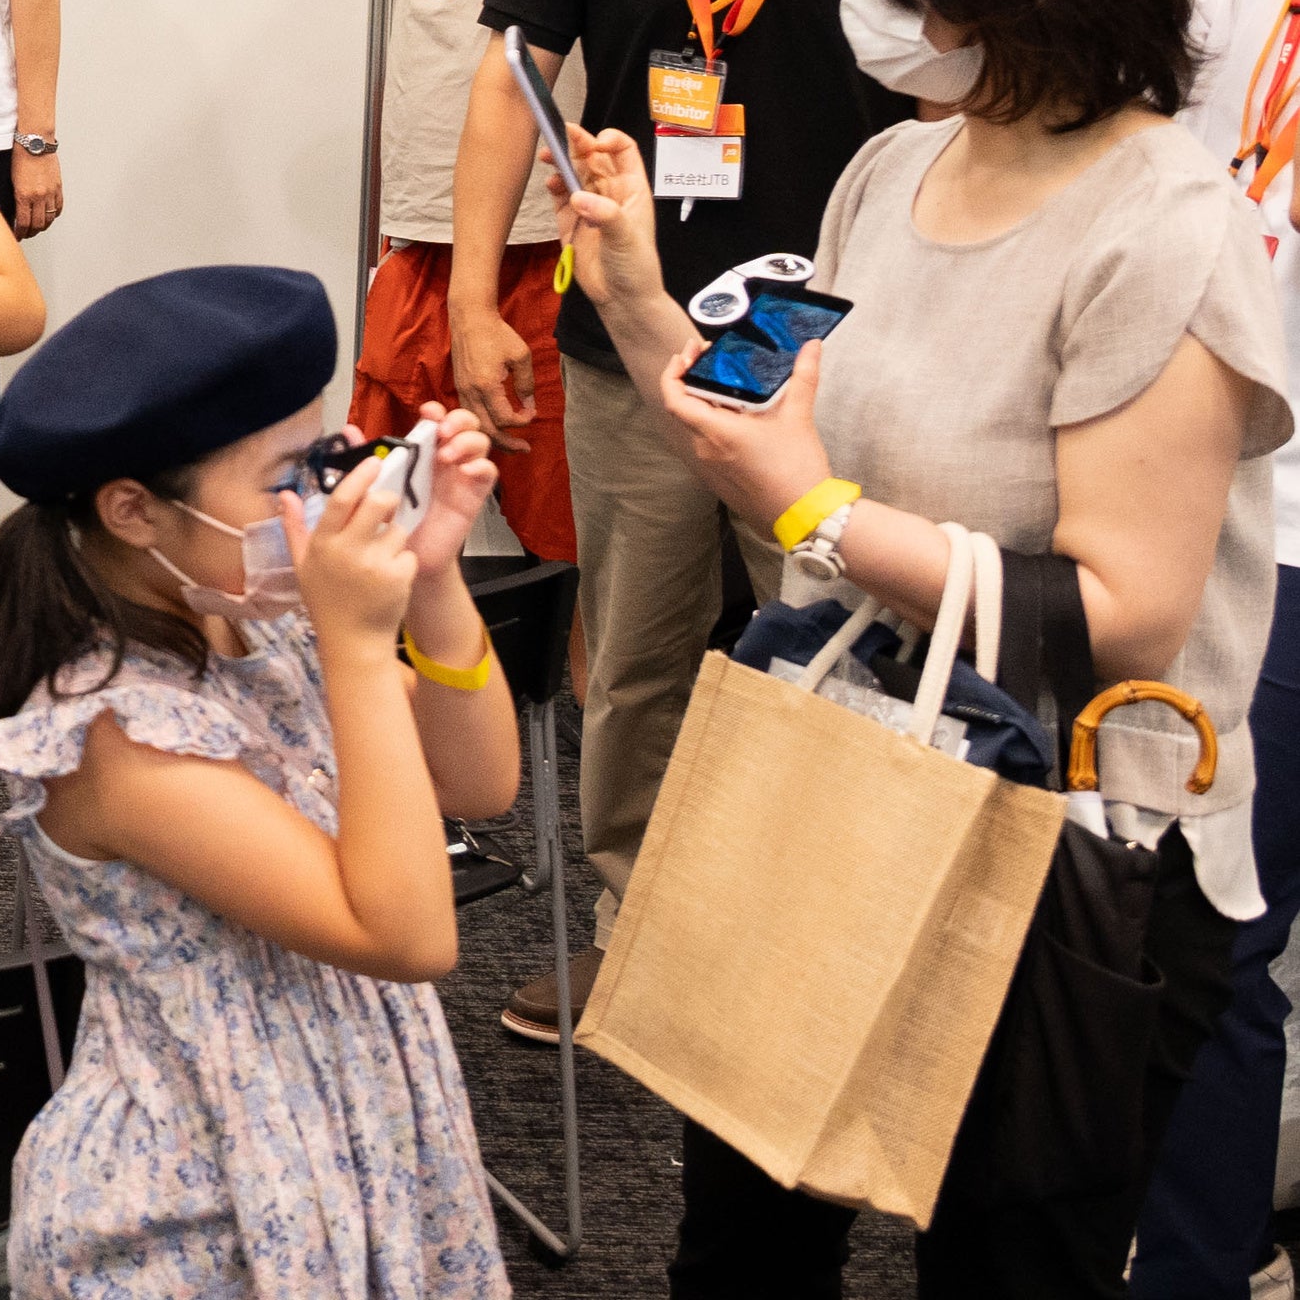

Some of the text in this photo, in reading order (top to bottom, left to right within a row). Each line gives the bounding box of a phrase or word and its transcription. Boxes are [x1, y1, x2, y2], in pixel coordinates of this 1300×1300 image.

[651, 99, 711, 121] Exhibitor
[663, 173, 730, 187] 株式会社JTB
